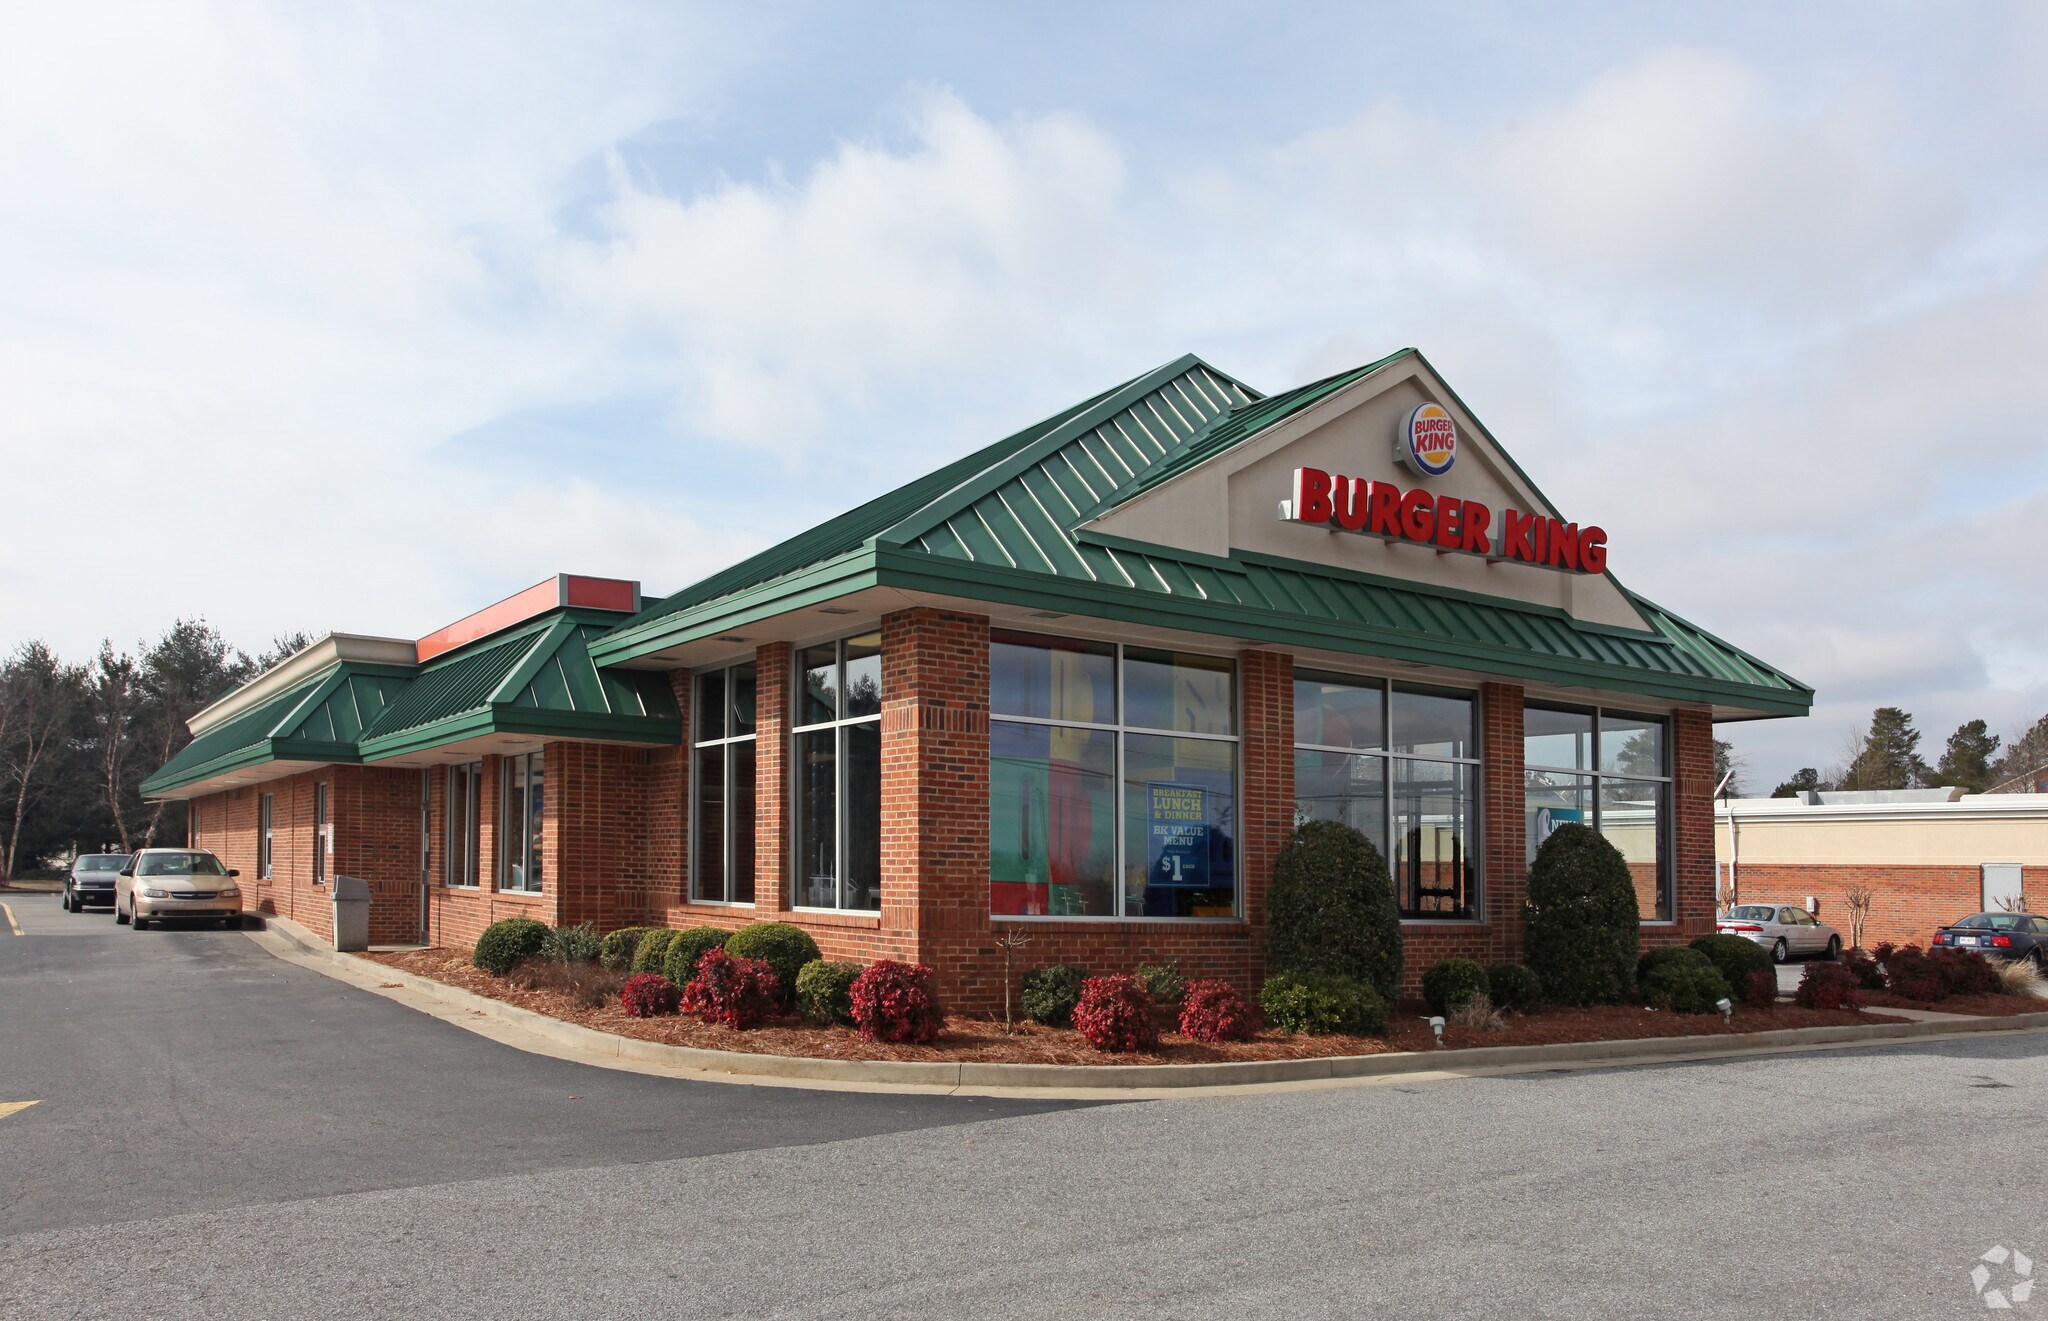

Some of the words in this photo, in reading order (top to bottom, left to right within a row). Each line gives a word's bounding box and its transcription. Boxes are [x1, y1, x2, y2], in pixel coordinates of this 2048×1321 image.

[1415, 419, 1453, 435] BURGER
[1415, 432, 1454, 453] KING
[1298, 466, 1491, 554] BURGER
[1503, 508, 1607, 574] KING
[1153, 788, 1202, 798] BREAKFAST
[1153, 797, 1201, 811] LUNCH
[1154, 811, 1162, 820] &
[1165, 811, 1202, 820] DINNER
[1153, 825, 1168, 835] BK
[1171, 826, 1204, 836] VALUE
[1163, 836, 1194, 846] MENU
[1161, 855, 1183, 881] $1
